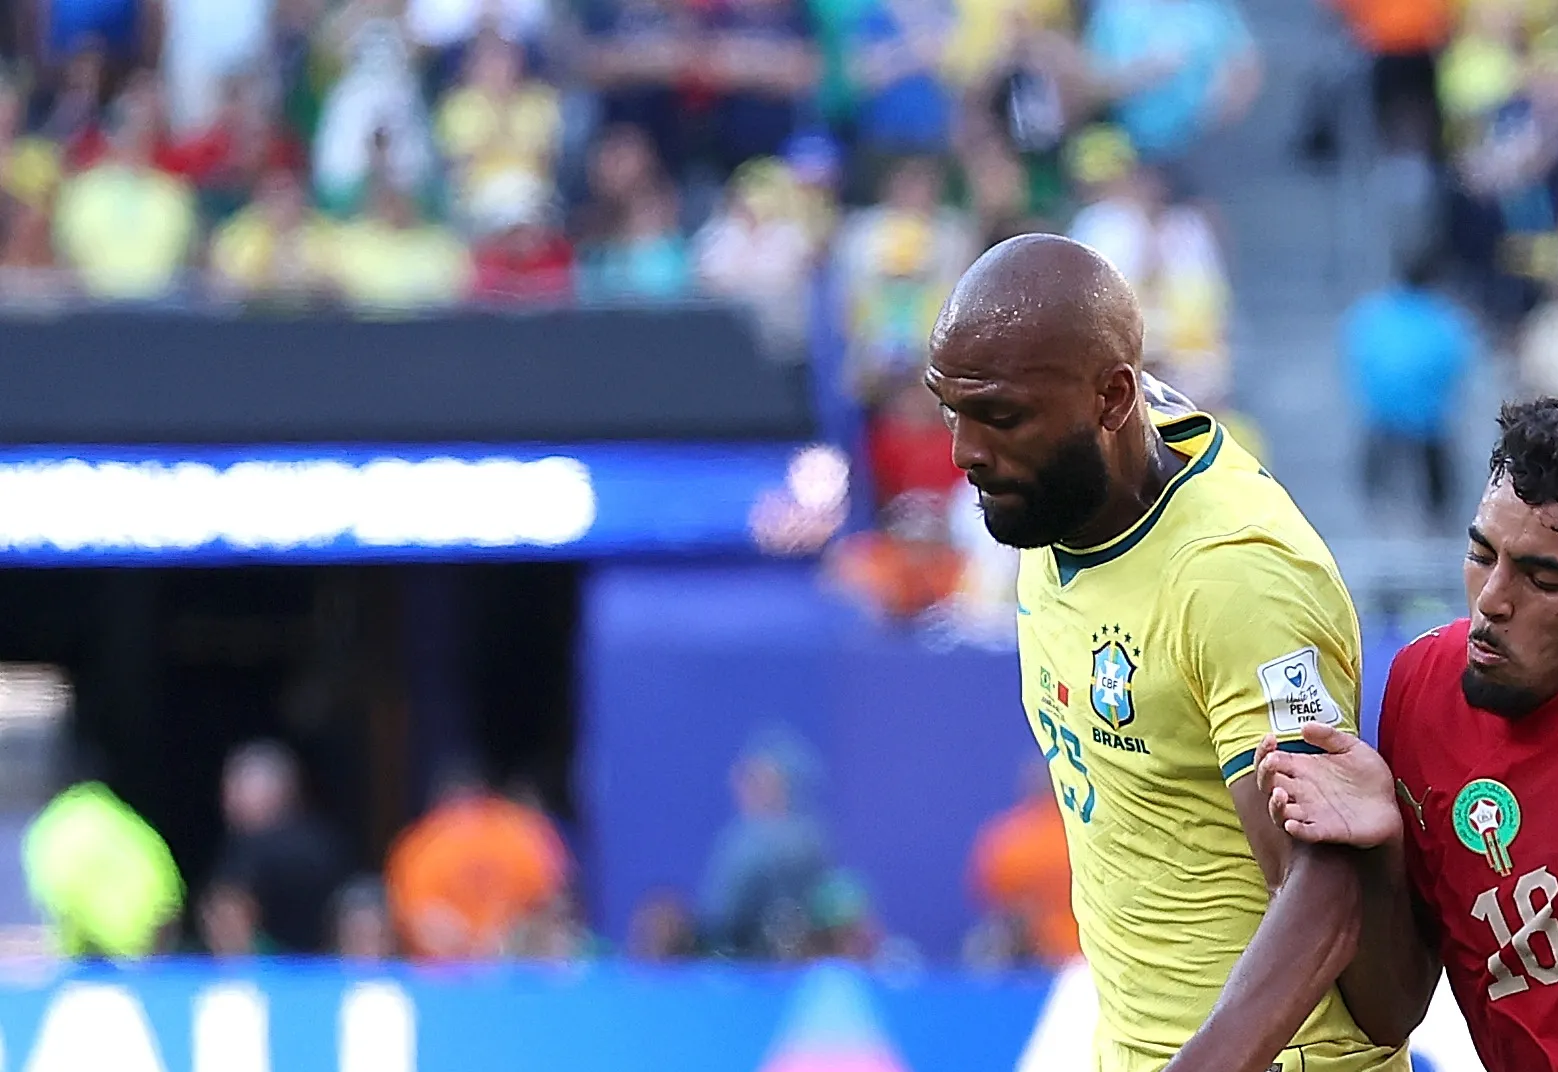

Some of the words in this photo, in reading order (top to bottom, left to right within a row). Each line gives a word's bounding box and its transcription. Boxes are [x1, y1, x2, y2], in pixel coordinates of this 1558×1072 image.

[1101, 676, 1118, 690] CBF
[1290, 699, 1323, 715] PEACE
[1297, 715, 1317, 723] FIFA
[1092, 726, 1151, 755] BRASIL
